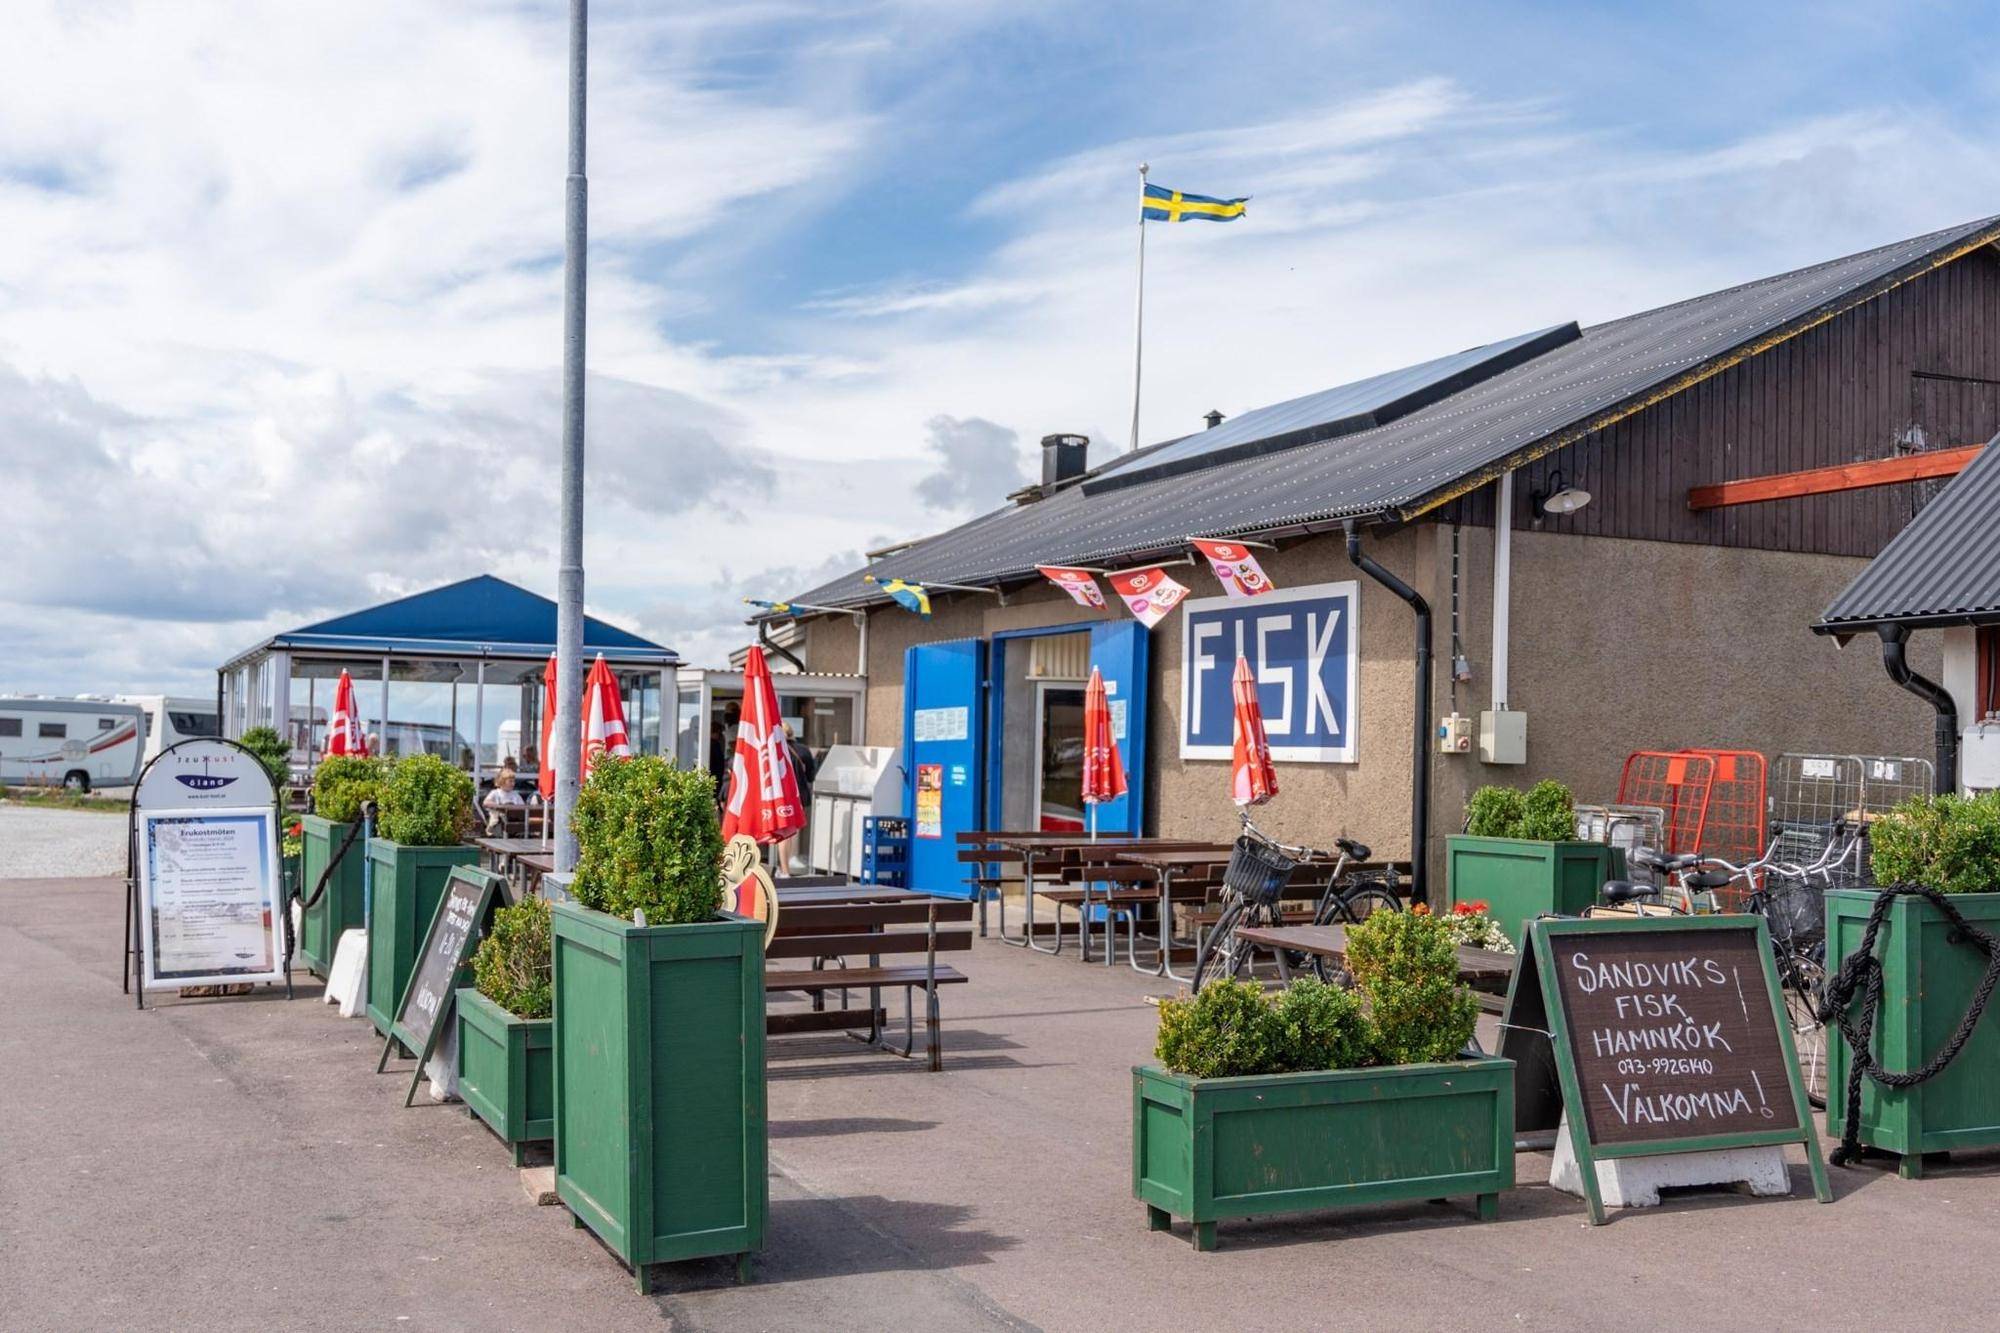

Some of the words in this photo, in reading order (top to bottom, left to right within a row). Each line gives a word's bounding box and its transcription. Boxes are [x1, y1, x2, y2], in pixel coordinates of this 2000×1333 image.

[1573, 952, 1726, 995] SANDVIKS
[1615, 994, 1688, 1019] FISK
[1593, 1016, 1732, 1057] HAMNKÖK
[1618, 1058, 1712, 1075] 073-9926140
